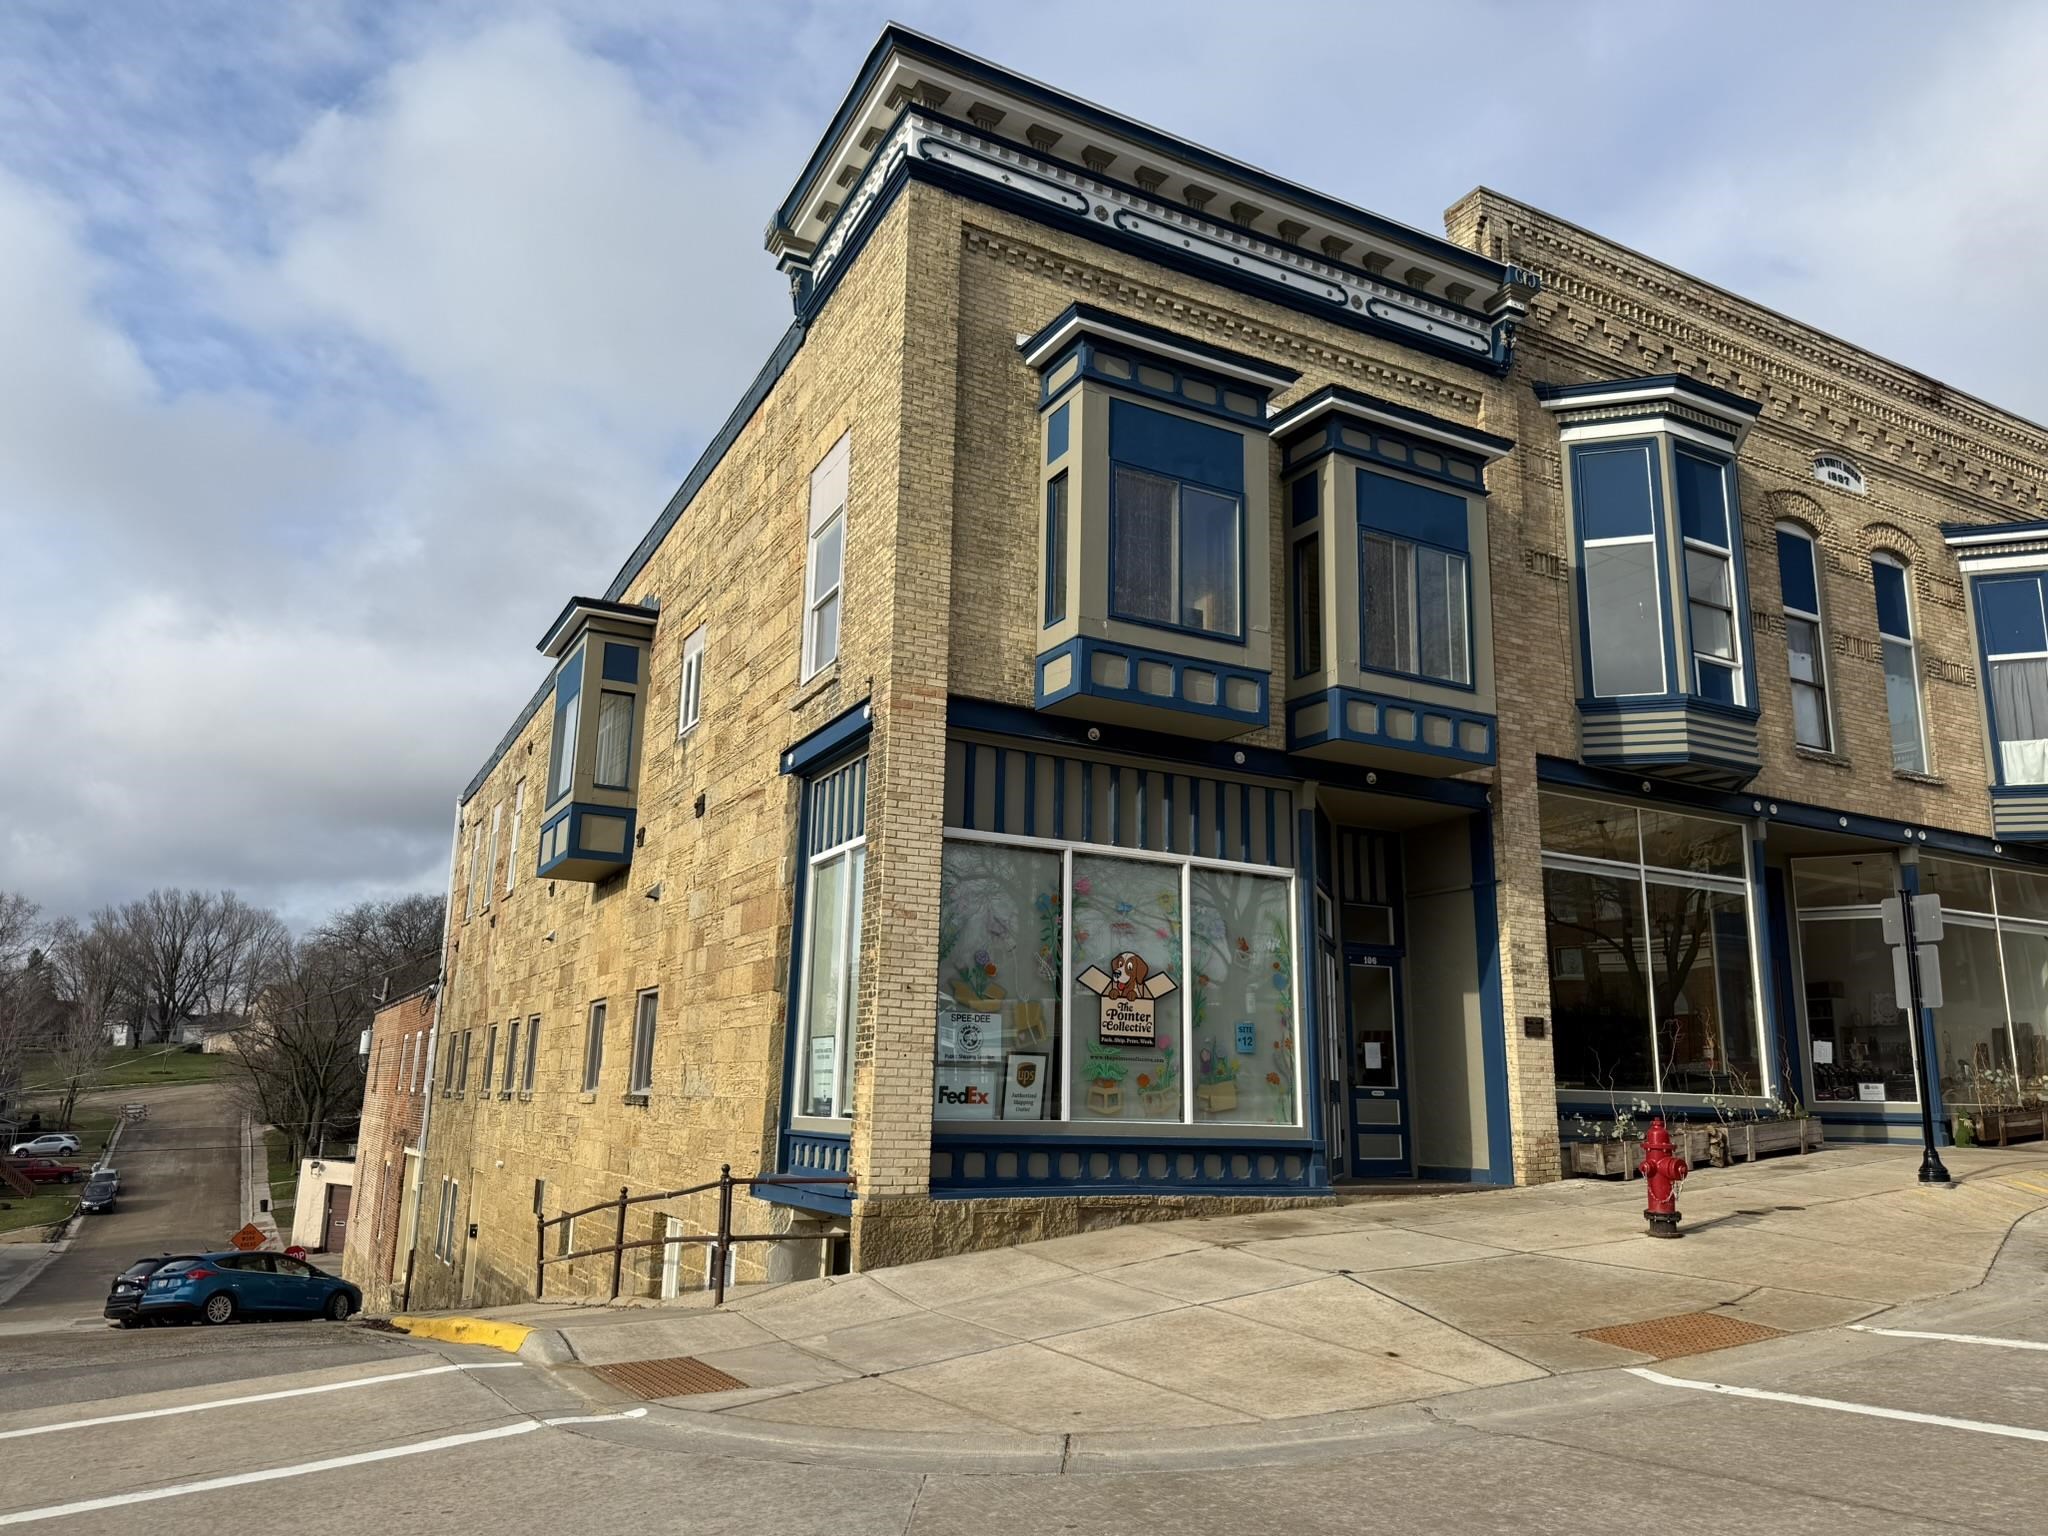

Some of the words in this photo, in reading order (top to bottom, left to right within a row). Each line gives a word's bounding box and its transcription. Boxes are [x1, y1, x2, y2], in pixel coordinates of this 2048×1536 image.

[1117, 1001, 1133, 1012] The
[951, 1013, 991, 1023] SPEE-DEE
[1106, 1008, 1151, 1022] Pointer
[1102, 1020, 1152, 1033] Collective
[1018, 1070, 1034, 1084] ups
[938, 1085, 989, 1104] FedEx
